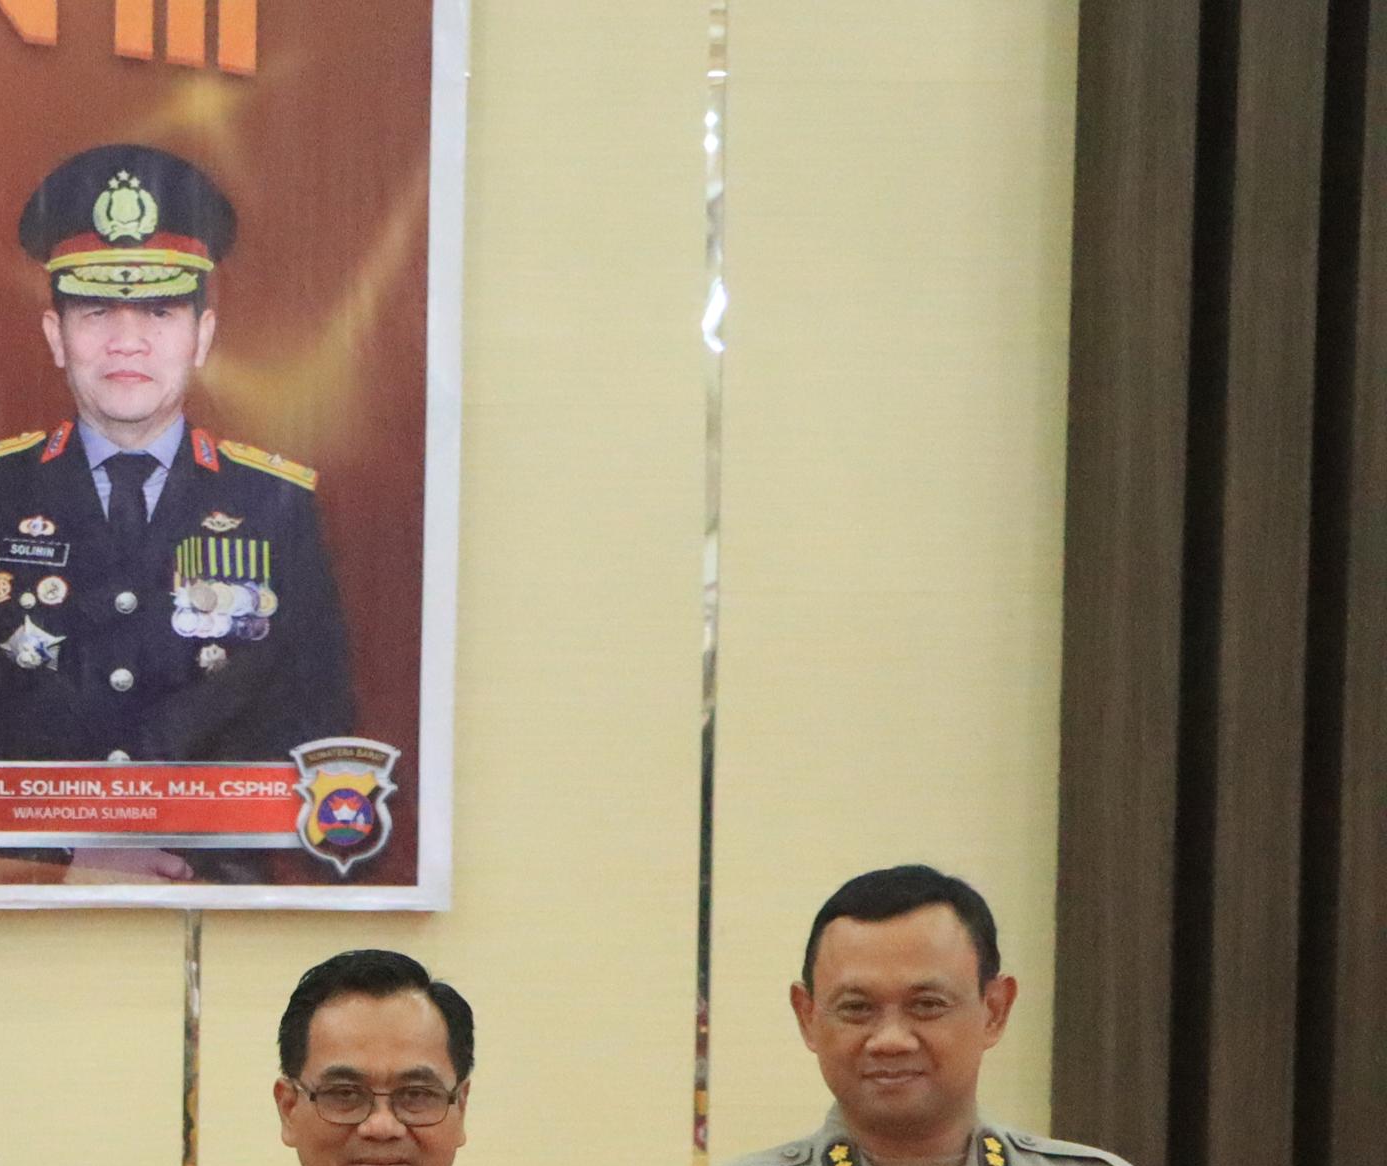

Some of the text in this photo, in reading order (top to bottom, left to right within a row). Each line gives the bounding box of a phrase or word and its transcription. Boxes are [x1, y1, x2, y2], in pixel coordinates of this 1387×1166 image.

[20, 780, 107, 798] SOLIHIN,
[13, 807, 157, 820] WAKAPOLDA SUMBAR
